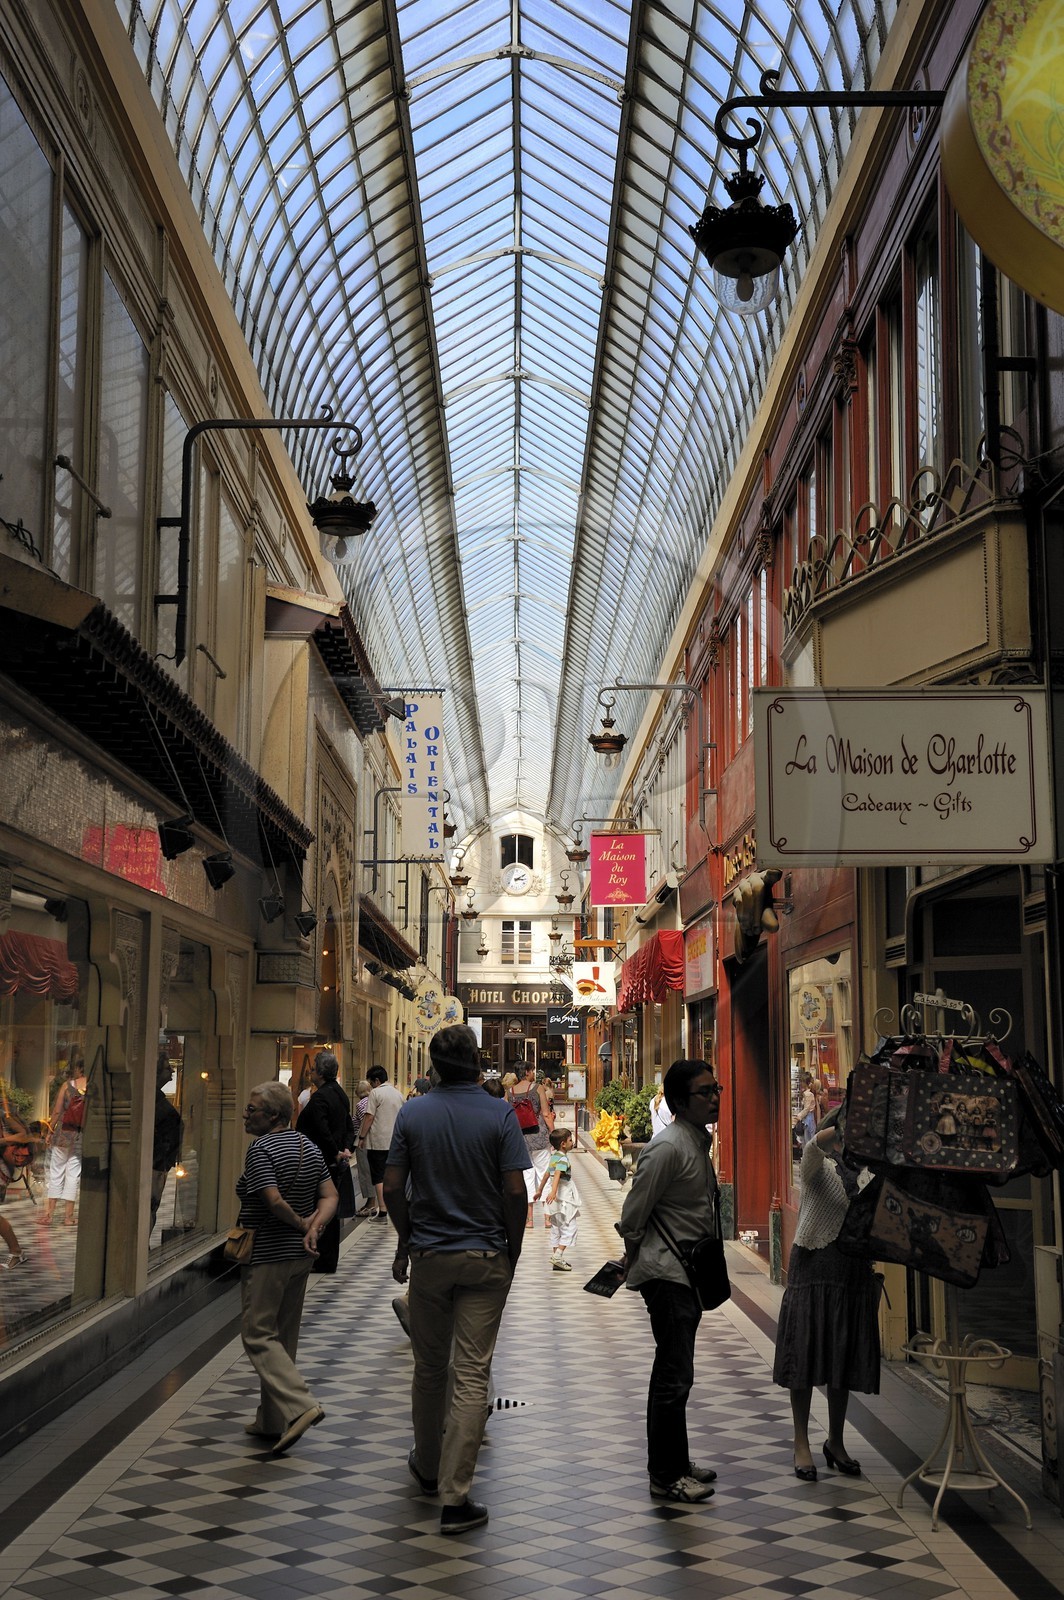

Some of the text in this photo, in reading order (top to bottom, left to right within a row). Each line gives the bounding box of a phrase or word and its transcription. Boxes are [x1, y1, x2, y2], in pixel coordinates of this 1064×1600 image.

[405, 703, 419, 794] PALAIS
[785, 733, 1017, 786] La Maison de Charlotte
[424, 726, 440, 849] ORIENTAL
[841, 792, 912, 825] Cadeaux
[933, 791, 973, 820] Gifts
[610, 839, 624, 850] La
[598, 851, 636, 861] Maison
[611, 861, 624, 873] du
[608, 873, 628, 887] Roy
[469, 988, 506, 1004] HÔTEL
